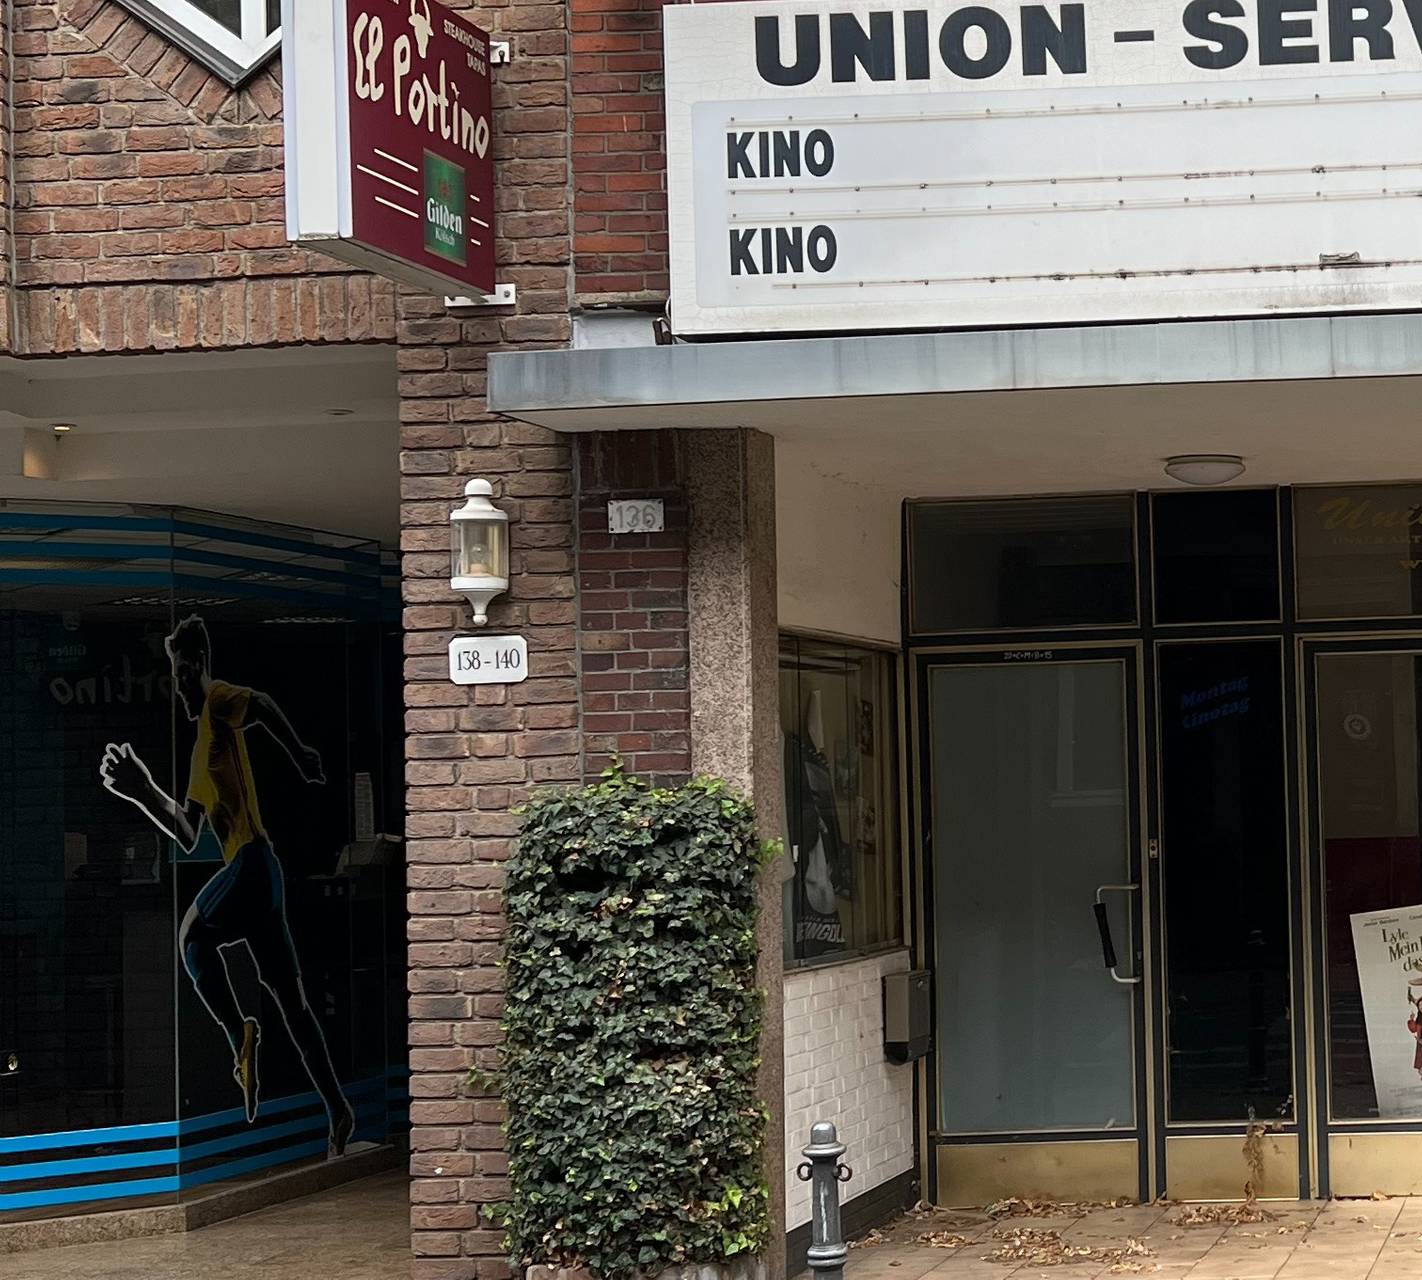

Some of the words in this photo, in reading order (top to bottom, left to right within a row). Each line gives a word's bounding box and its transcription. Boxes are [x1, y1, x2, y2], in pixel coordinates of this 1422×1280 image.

[443, 19, 486, 57] STEAKHOUSE
[754, 4, 1087, 86] UNION
[466, 52, 487, 77] TAPAS
[393, 34, 489, 160] Portino
[727, 129, 835, 178] KINO
[427, 197, 463, 235] Gilden
[729, 225, 838, 275] KINO
[616, 504, 656, 529] 136
[1382, 928, 1408, 945] Lyle
[1389, 940, 1419, 963] Mein
